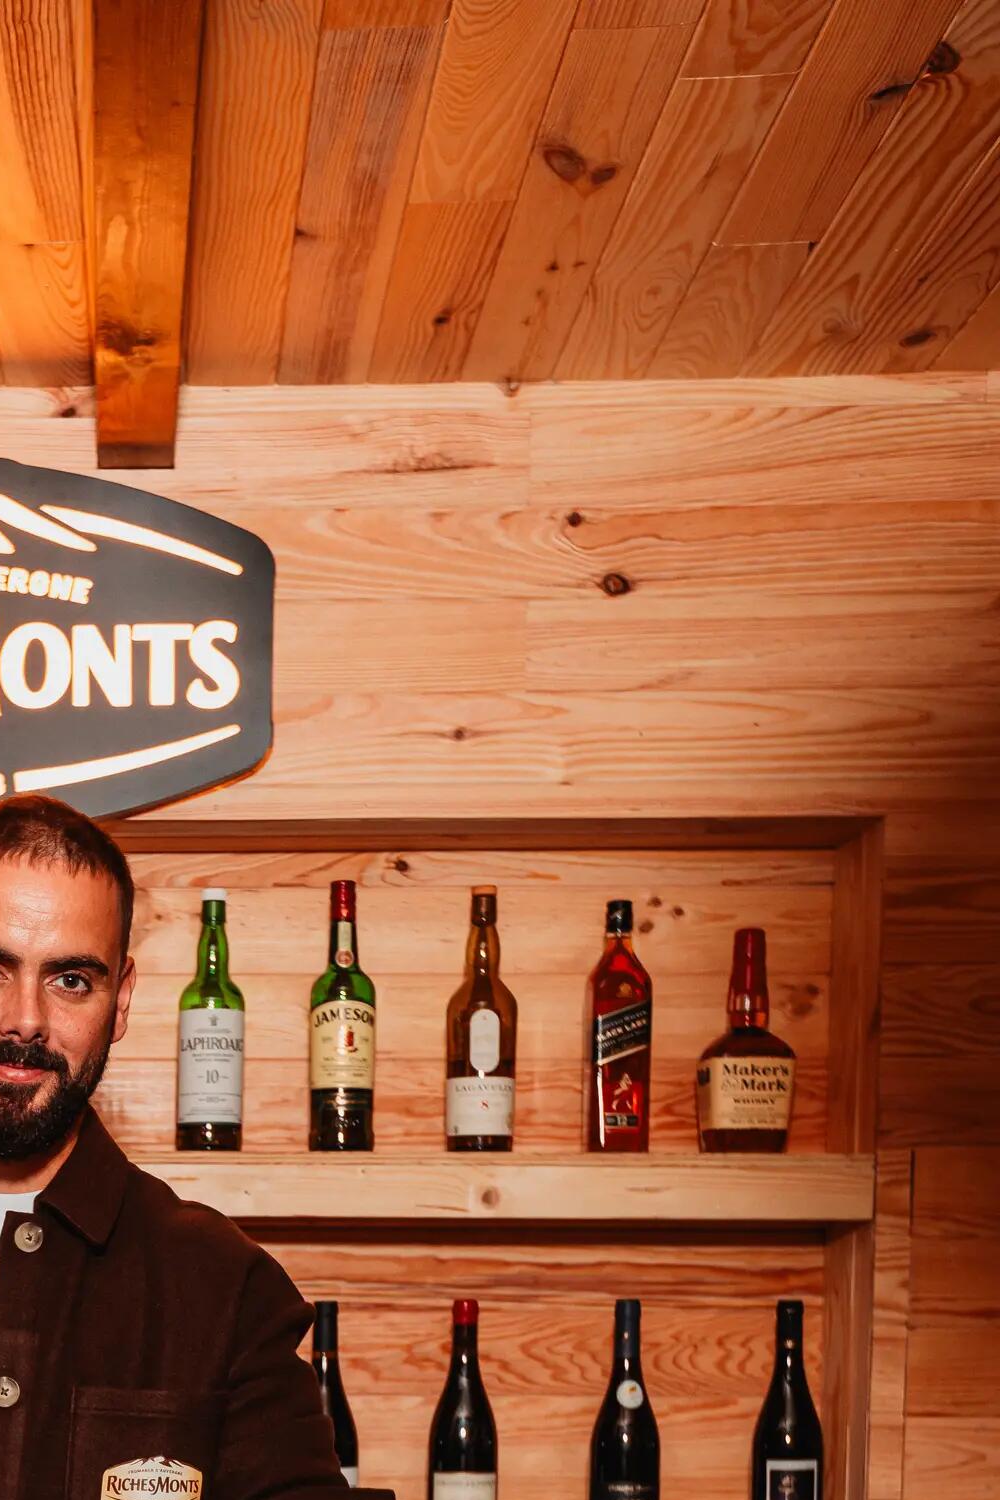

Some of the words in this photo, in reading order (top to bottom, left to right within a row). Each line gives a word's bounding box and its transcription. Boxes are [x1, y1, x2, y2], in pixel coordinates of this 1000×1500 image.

[206, 1069, 220, 1085] 10
[723, 1063, 790, 1077] Maker's
[741, 1078, 787, 1092] Mark
[106, 1475, 199, 1496] RICHESMONTS
